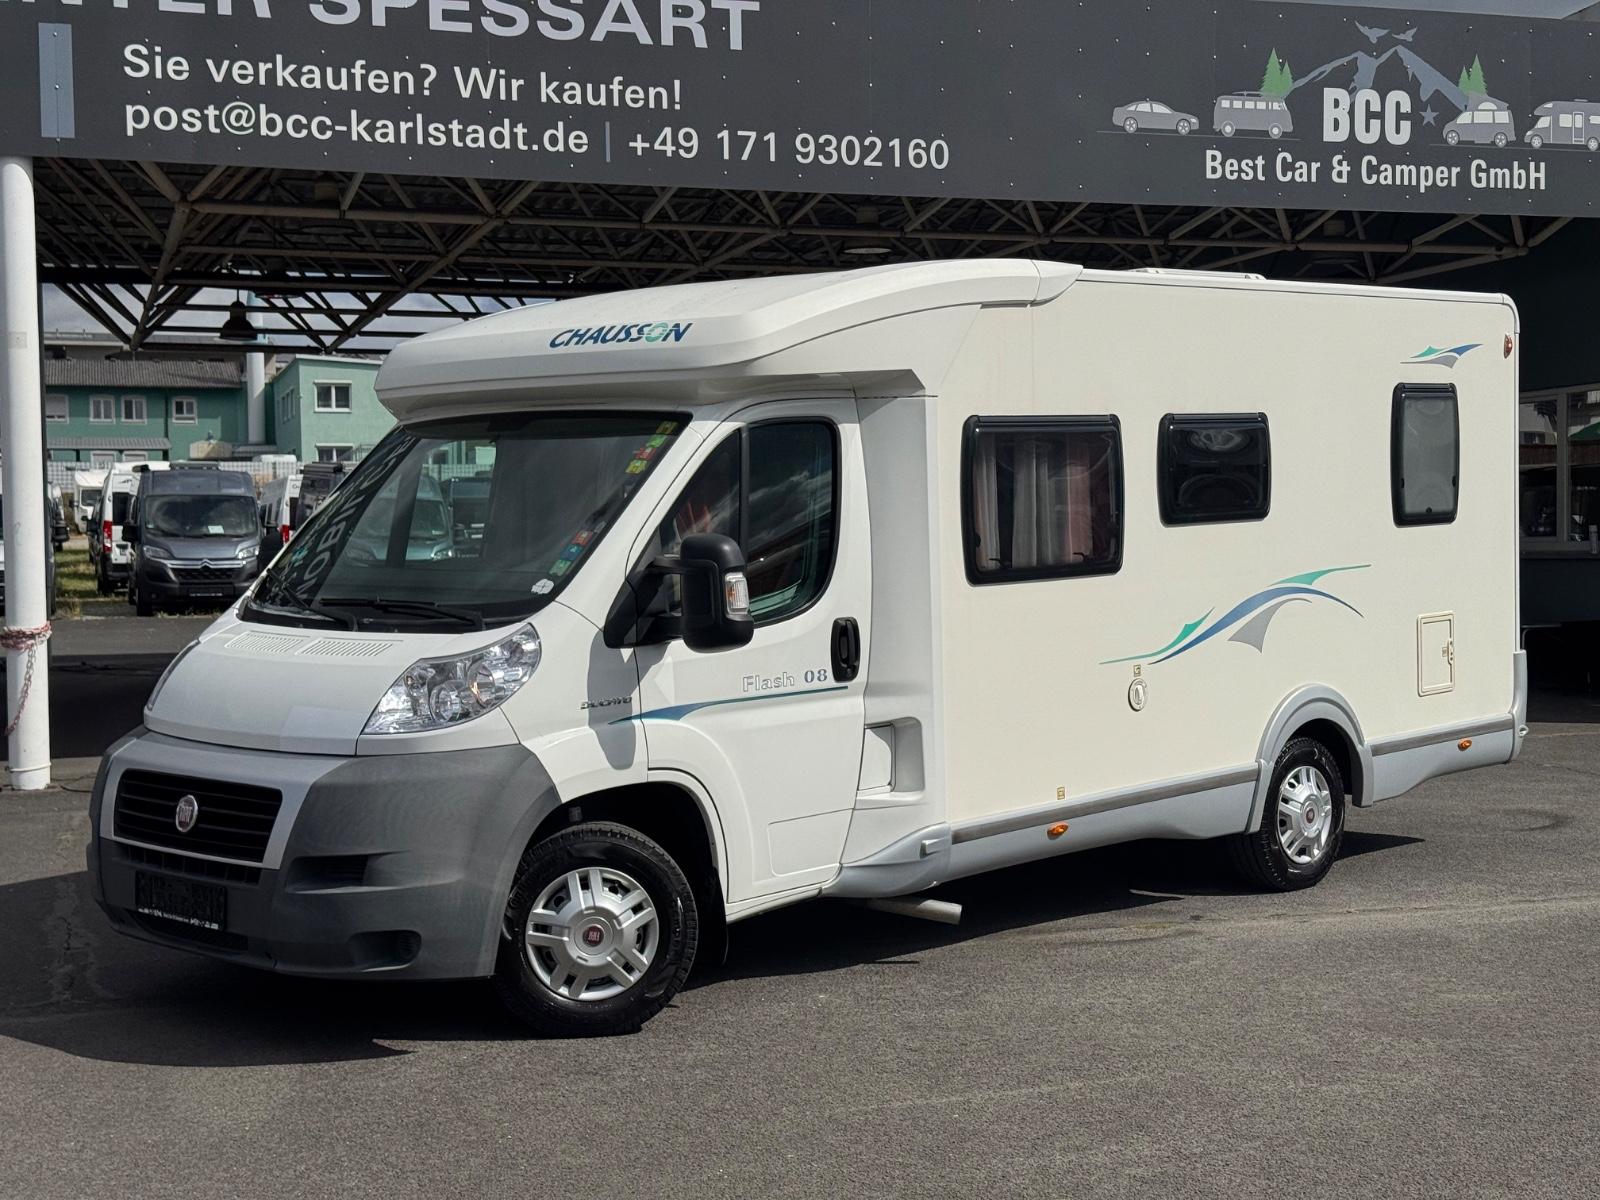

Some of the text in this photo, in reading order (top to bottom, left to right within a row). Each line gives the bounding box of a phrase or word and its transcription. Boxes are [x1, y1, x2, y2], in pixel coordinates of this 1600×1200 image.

[123, 43, 681, 110] Sie verkaufen? Wir kaufen!
[125, 101, 949, 170] post@bcc-karlstadt.de +49 171 9302160
[1322, 87, 1412, 146] BCC
[1205, 149, 1546, 193] Best Car & Camper GmbH
[549, 322, 693, 348] CHAUSSON
[742, 668, 828, 693] Flash 08
